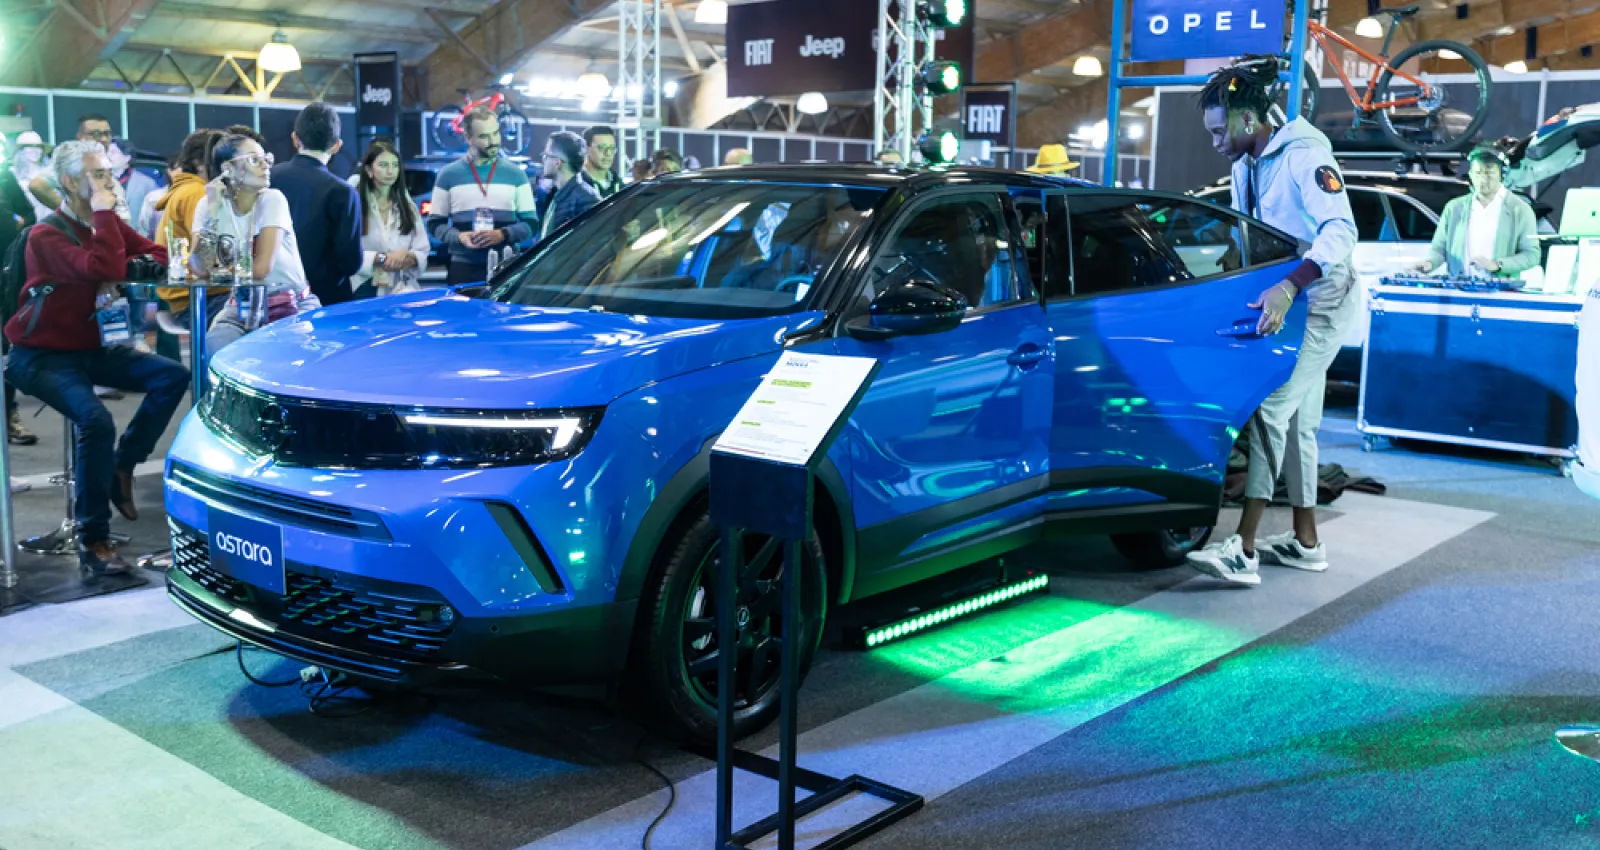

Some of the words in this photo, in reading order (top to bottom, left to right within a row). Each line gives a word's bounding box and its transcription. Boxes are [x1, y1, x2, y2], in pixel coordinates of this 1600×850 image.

[1149, 9, 1266, 35] OPEL
[744, 38, 774, 66] FIAT
[799, 34, 845, 59] Jeep
[363, 84, 392, 106] Jeep
[968, 104, 1005, 133] FIAT
